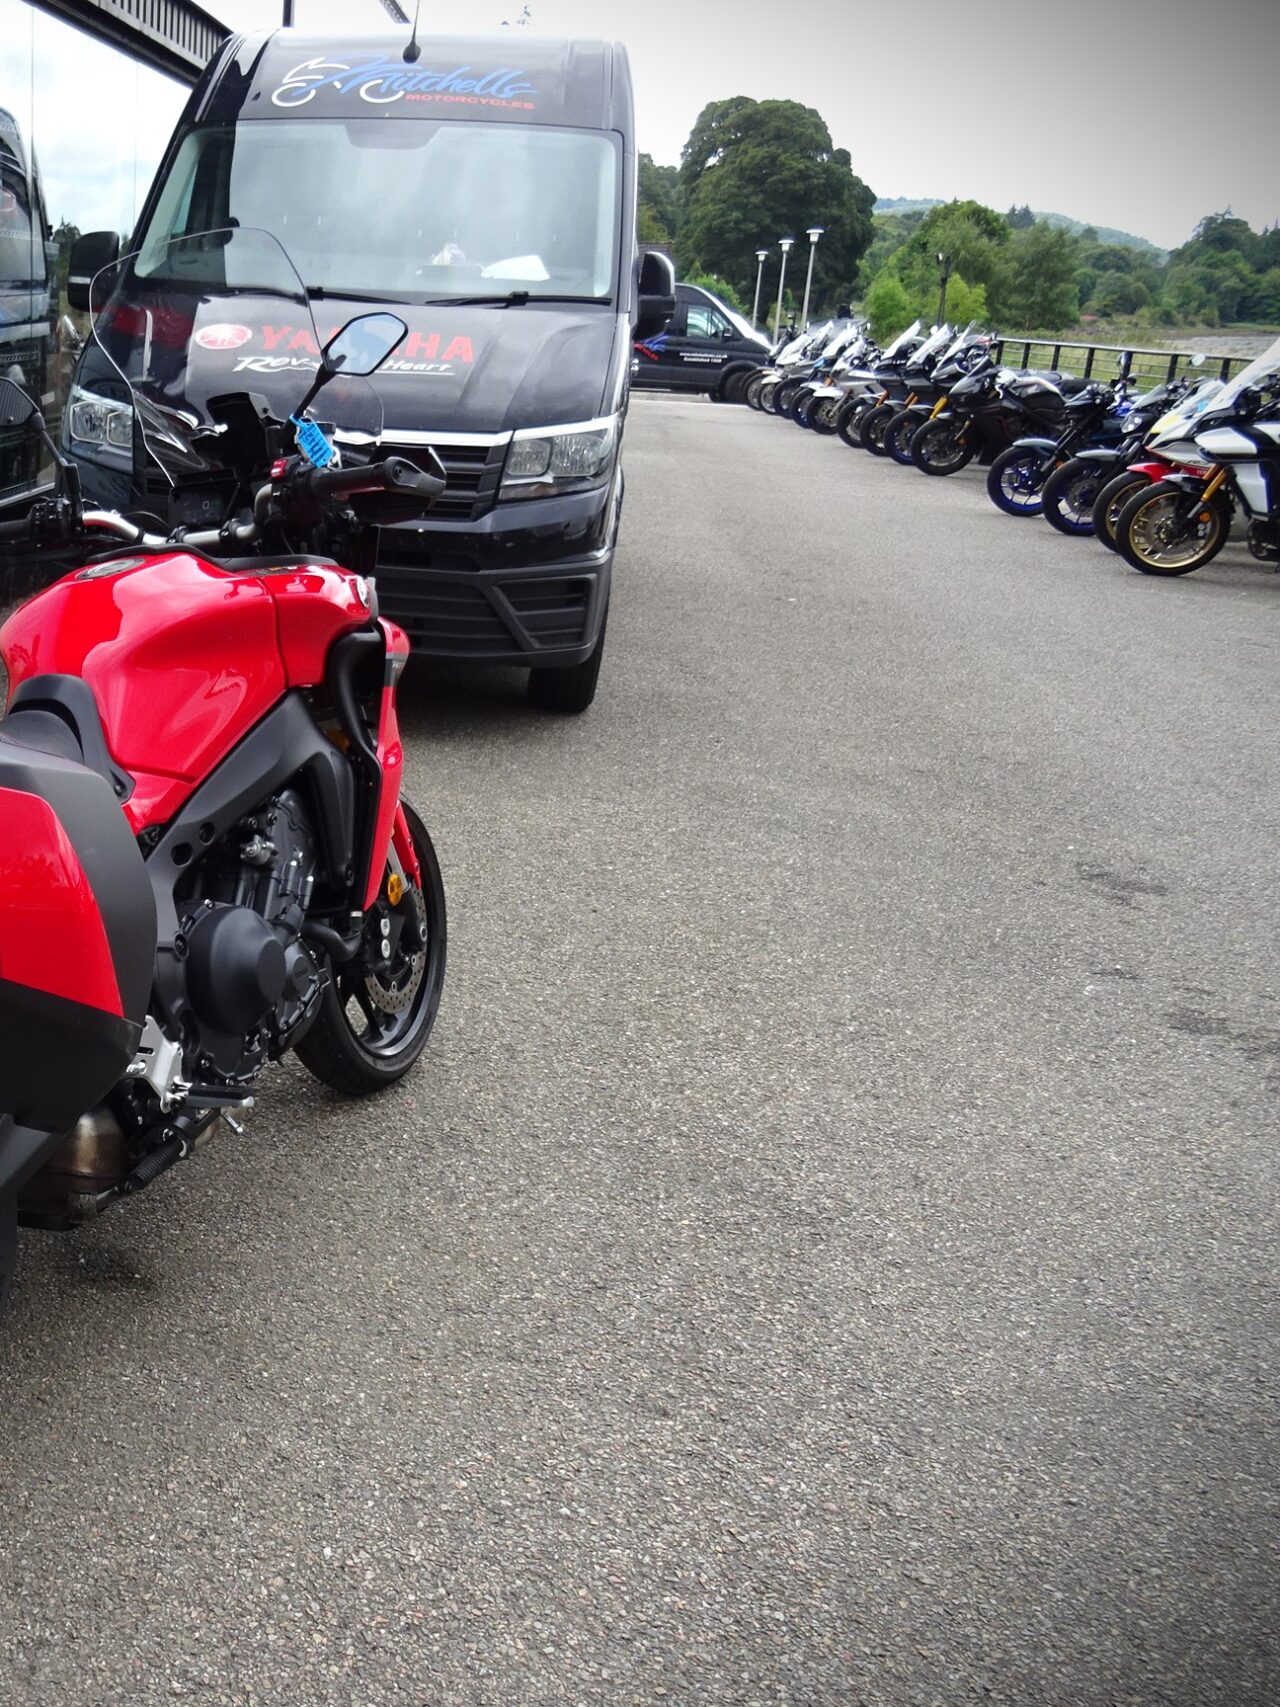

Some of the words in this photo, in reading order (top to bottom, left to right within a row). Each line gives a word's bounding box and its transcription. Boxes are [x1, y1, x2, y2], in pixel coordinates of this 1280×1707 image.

[291, 54, 539, 98] Mitchells
[405, 93, 535, 110] MOTORCYCLES
[261, 324, 475, 365] YAHA
[380, 358, 453, 373] Heart
